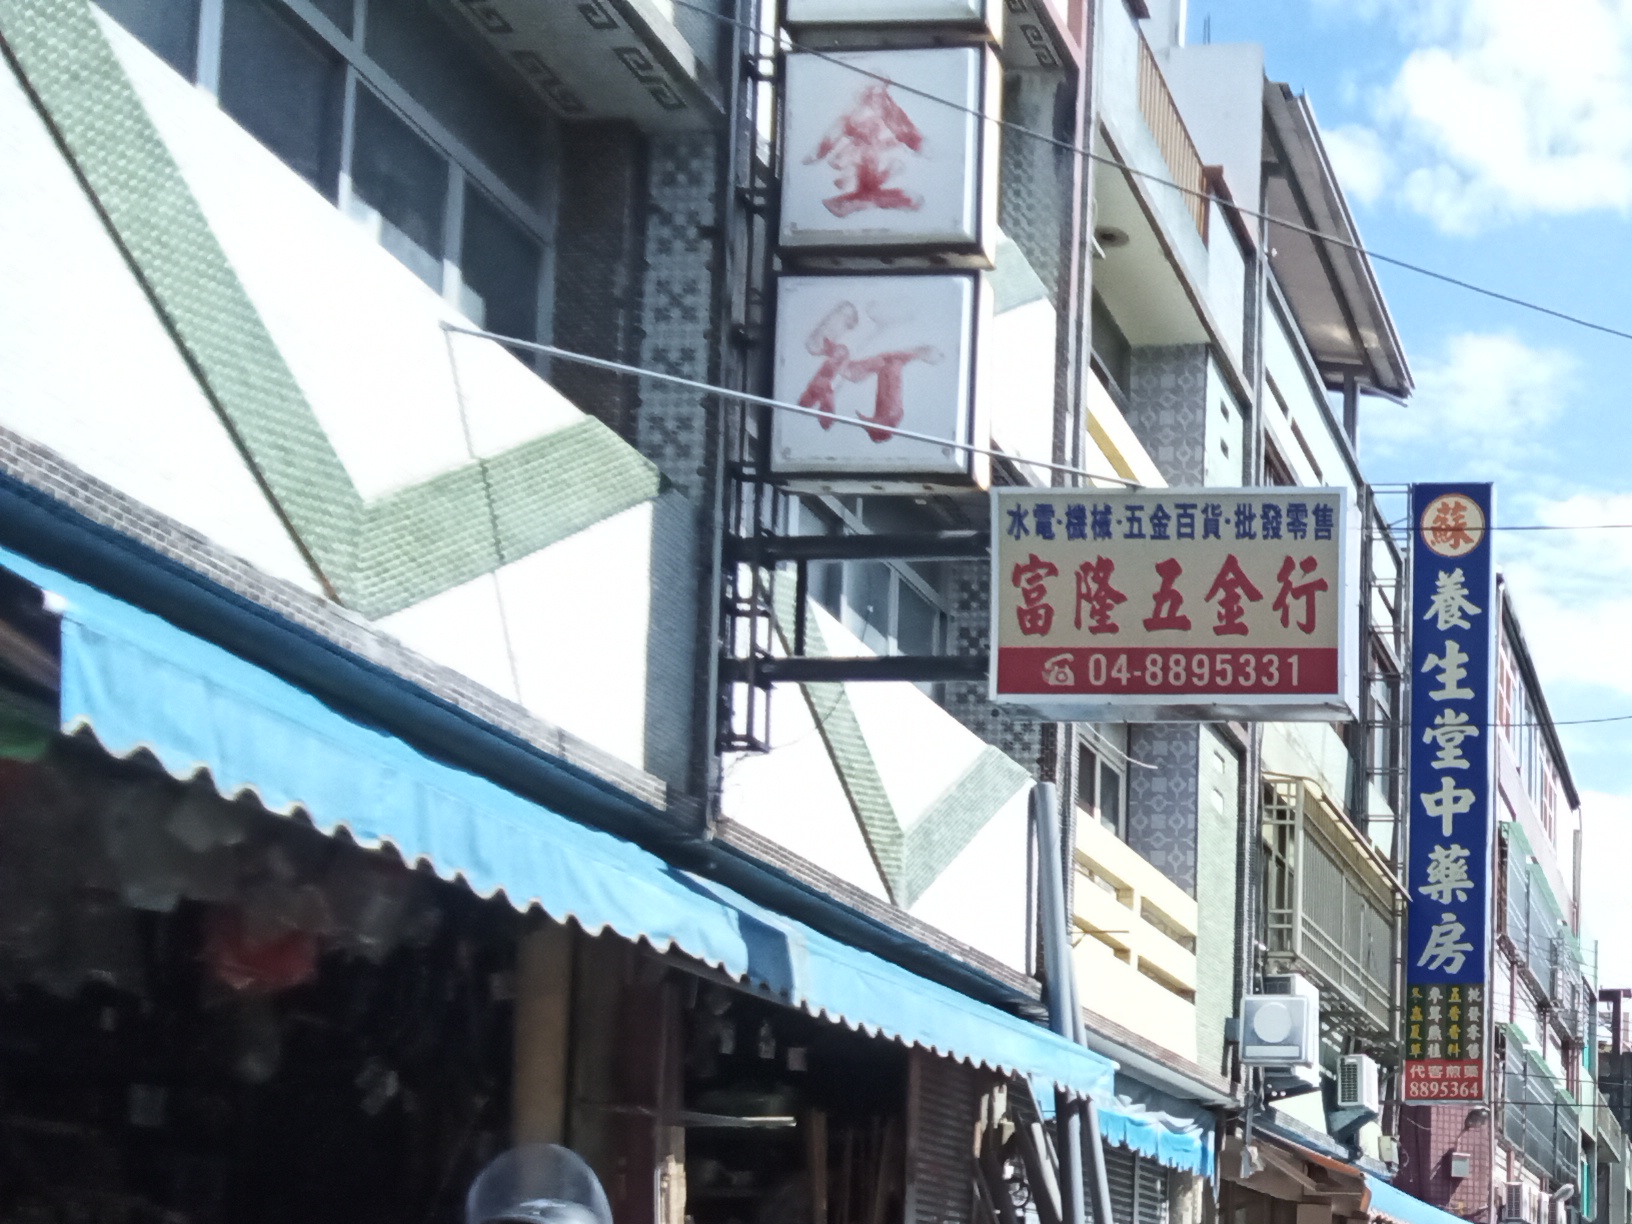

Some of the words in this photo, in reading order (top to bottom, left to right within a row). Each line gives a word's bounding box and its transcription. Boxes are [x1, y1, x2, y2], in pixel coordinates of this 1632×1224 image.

[1430, 500, 1475, 550] 蘇
[1010, 553, 1330, 637] 富隆五金行
[1087, 653, 1300, 687] 04-8895331
[1416, 567, 1482, 974] 養生堂中藥房
[1409, 1081, 1479, 1098] 8895364
